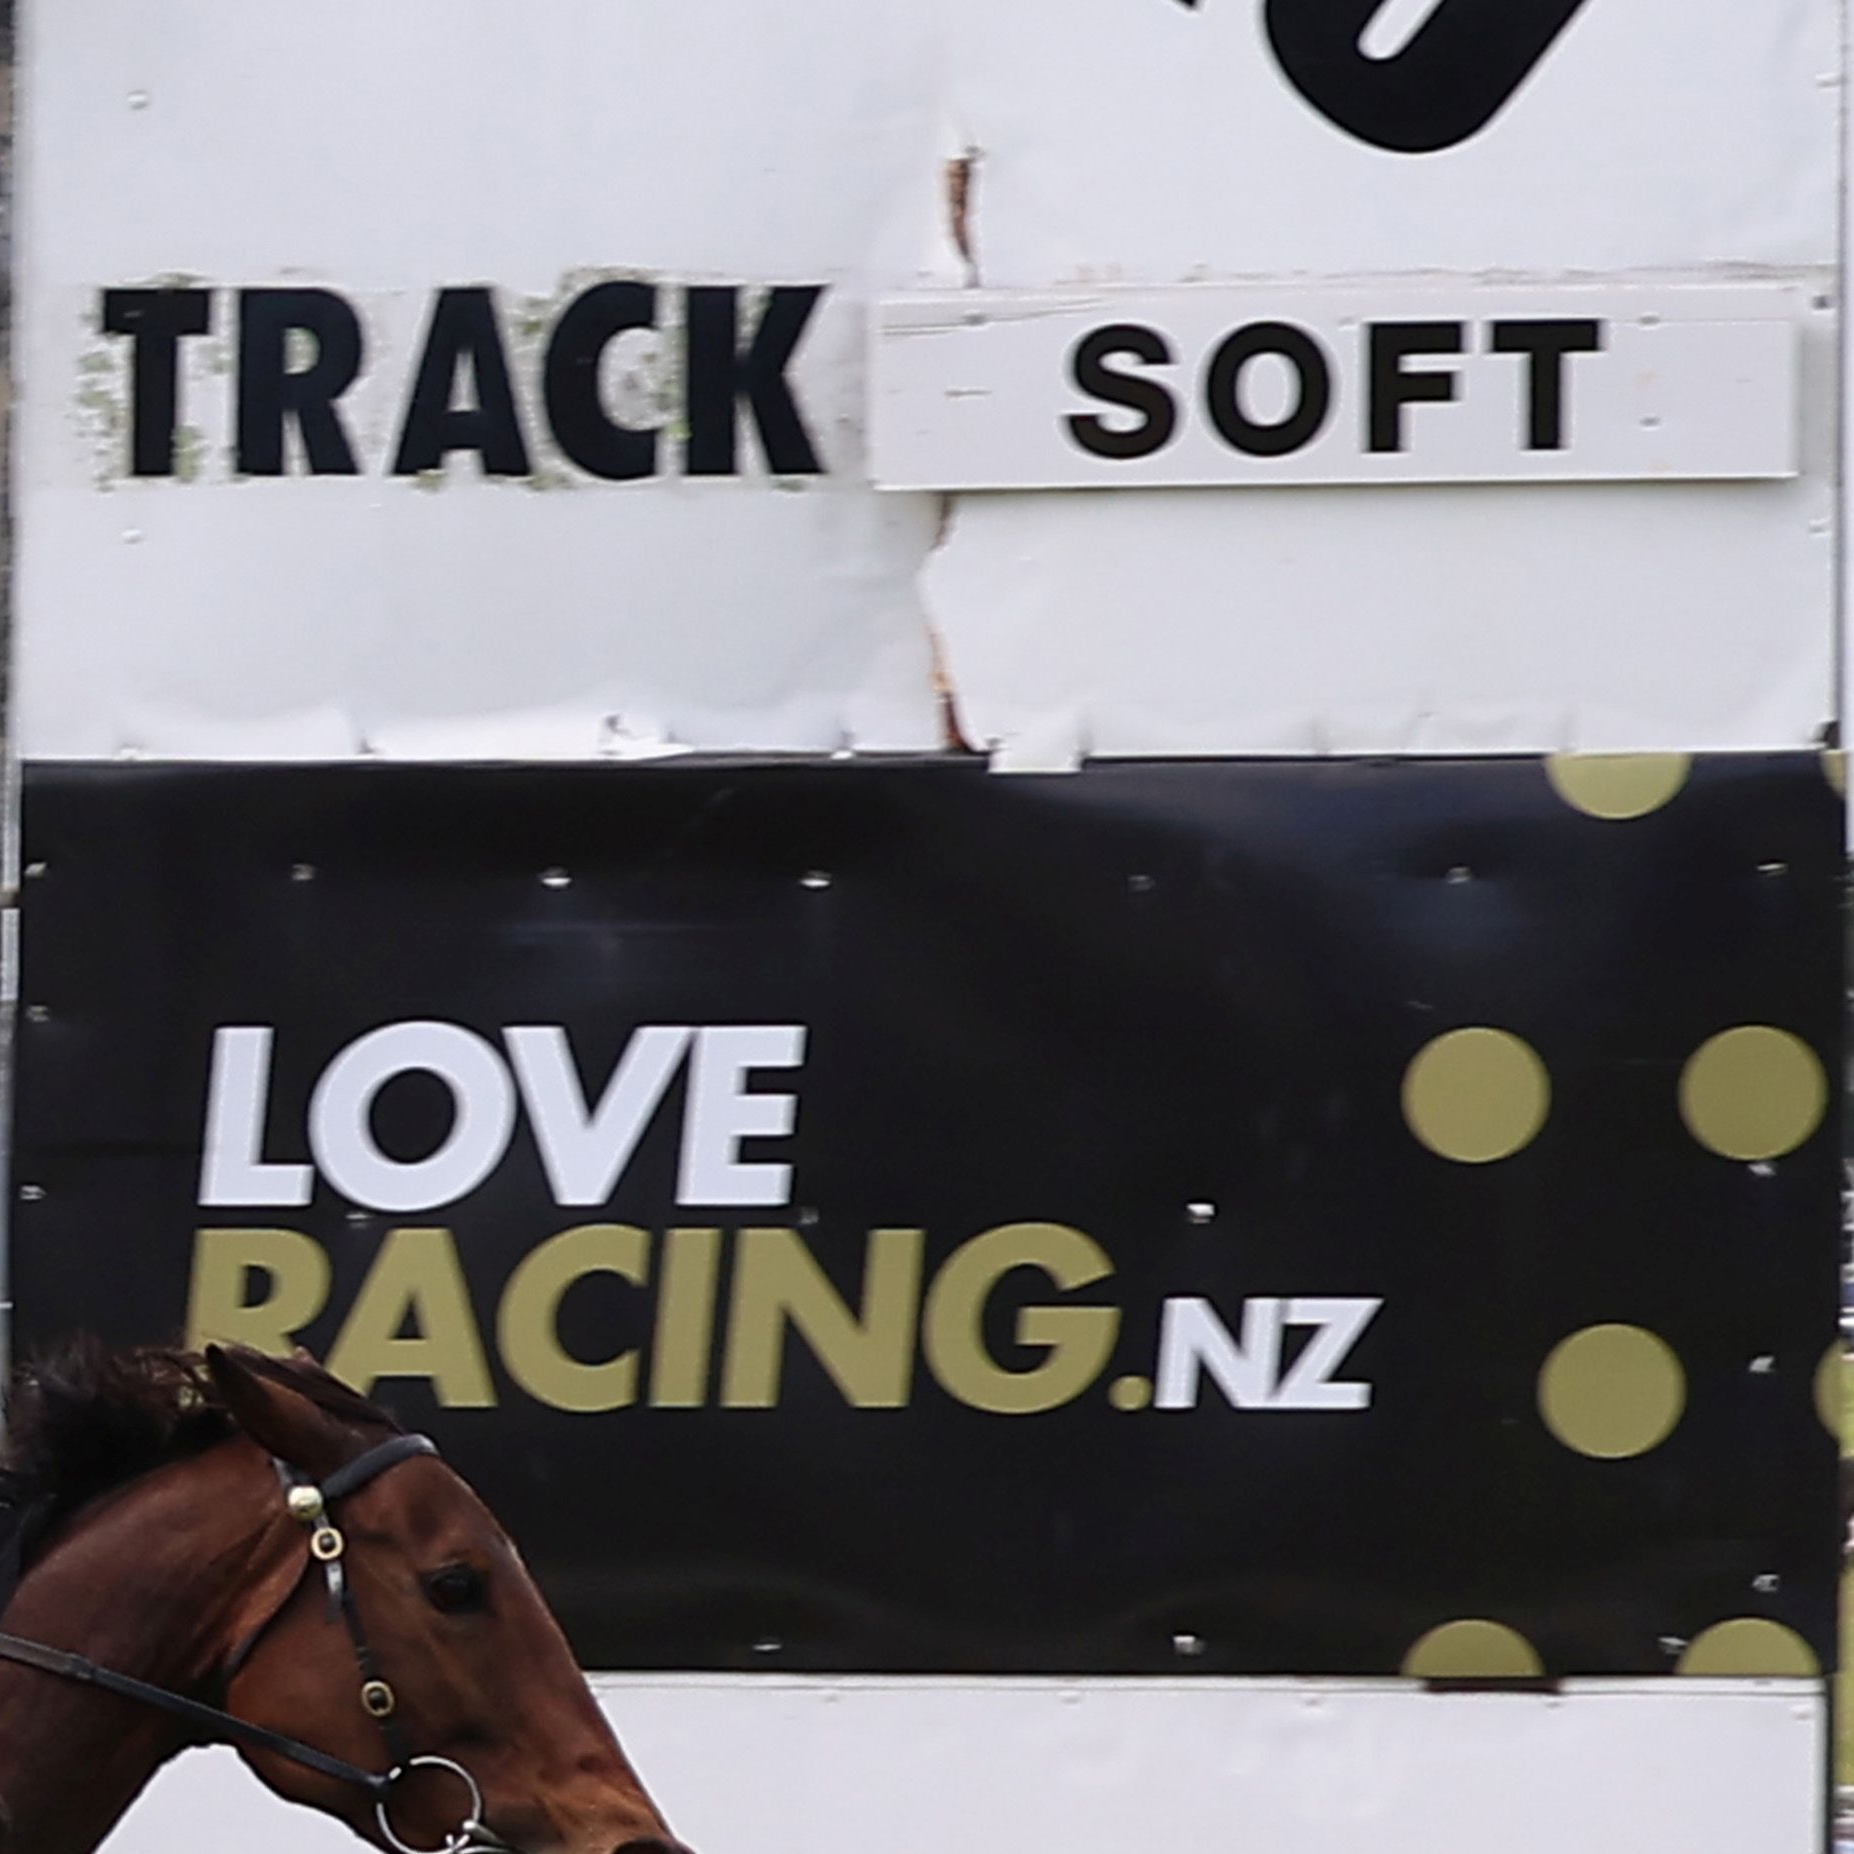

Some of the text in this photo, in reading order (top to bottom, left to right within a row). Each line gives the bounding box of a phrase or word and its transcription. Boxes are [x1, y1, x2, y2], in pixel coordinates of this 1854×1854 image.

[103, 281, 1603, 478] TRACK SOFT
[197, 1019, 807, 1211] LOVE
[184, 1222, 1384, 1414] RACING.NZ
